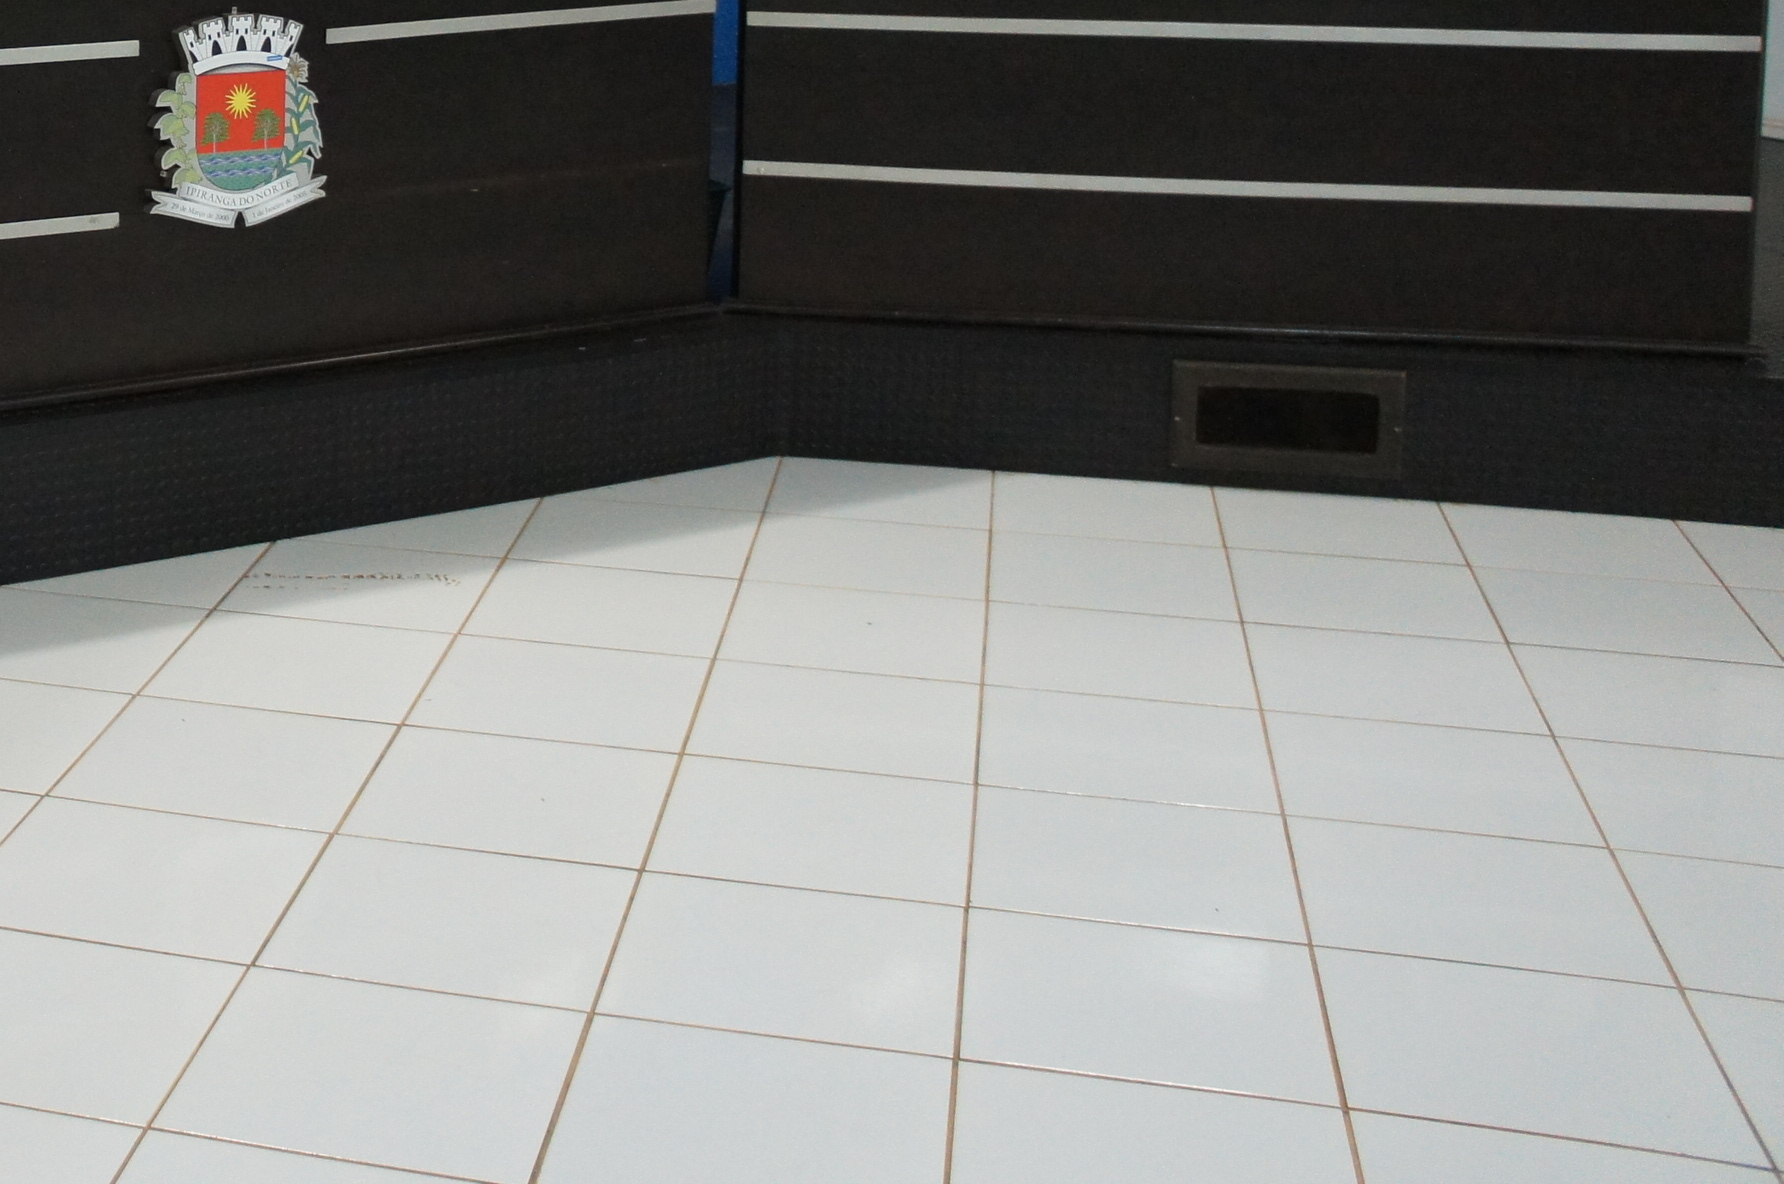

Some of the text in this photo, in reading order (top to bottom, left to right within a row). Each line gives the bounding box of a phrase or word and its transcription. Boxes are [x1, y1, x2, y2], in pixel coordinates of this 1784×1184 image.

[186, 178, 293, 207] IPIRANGA DO NORTE
